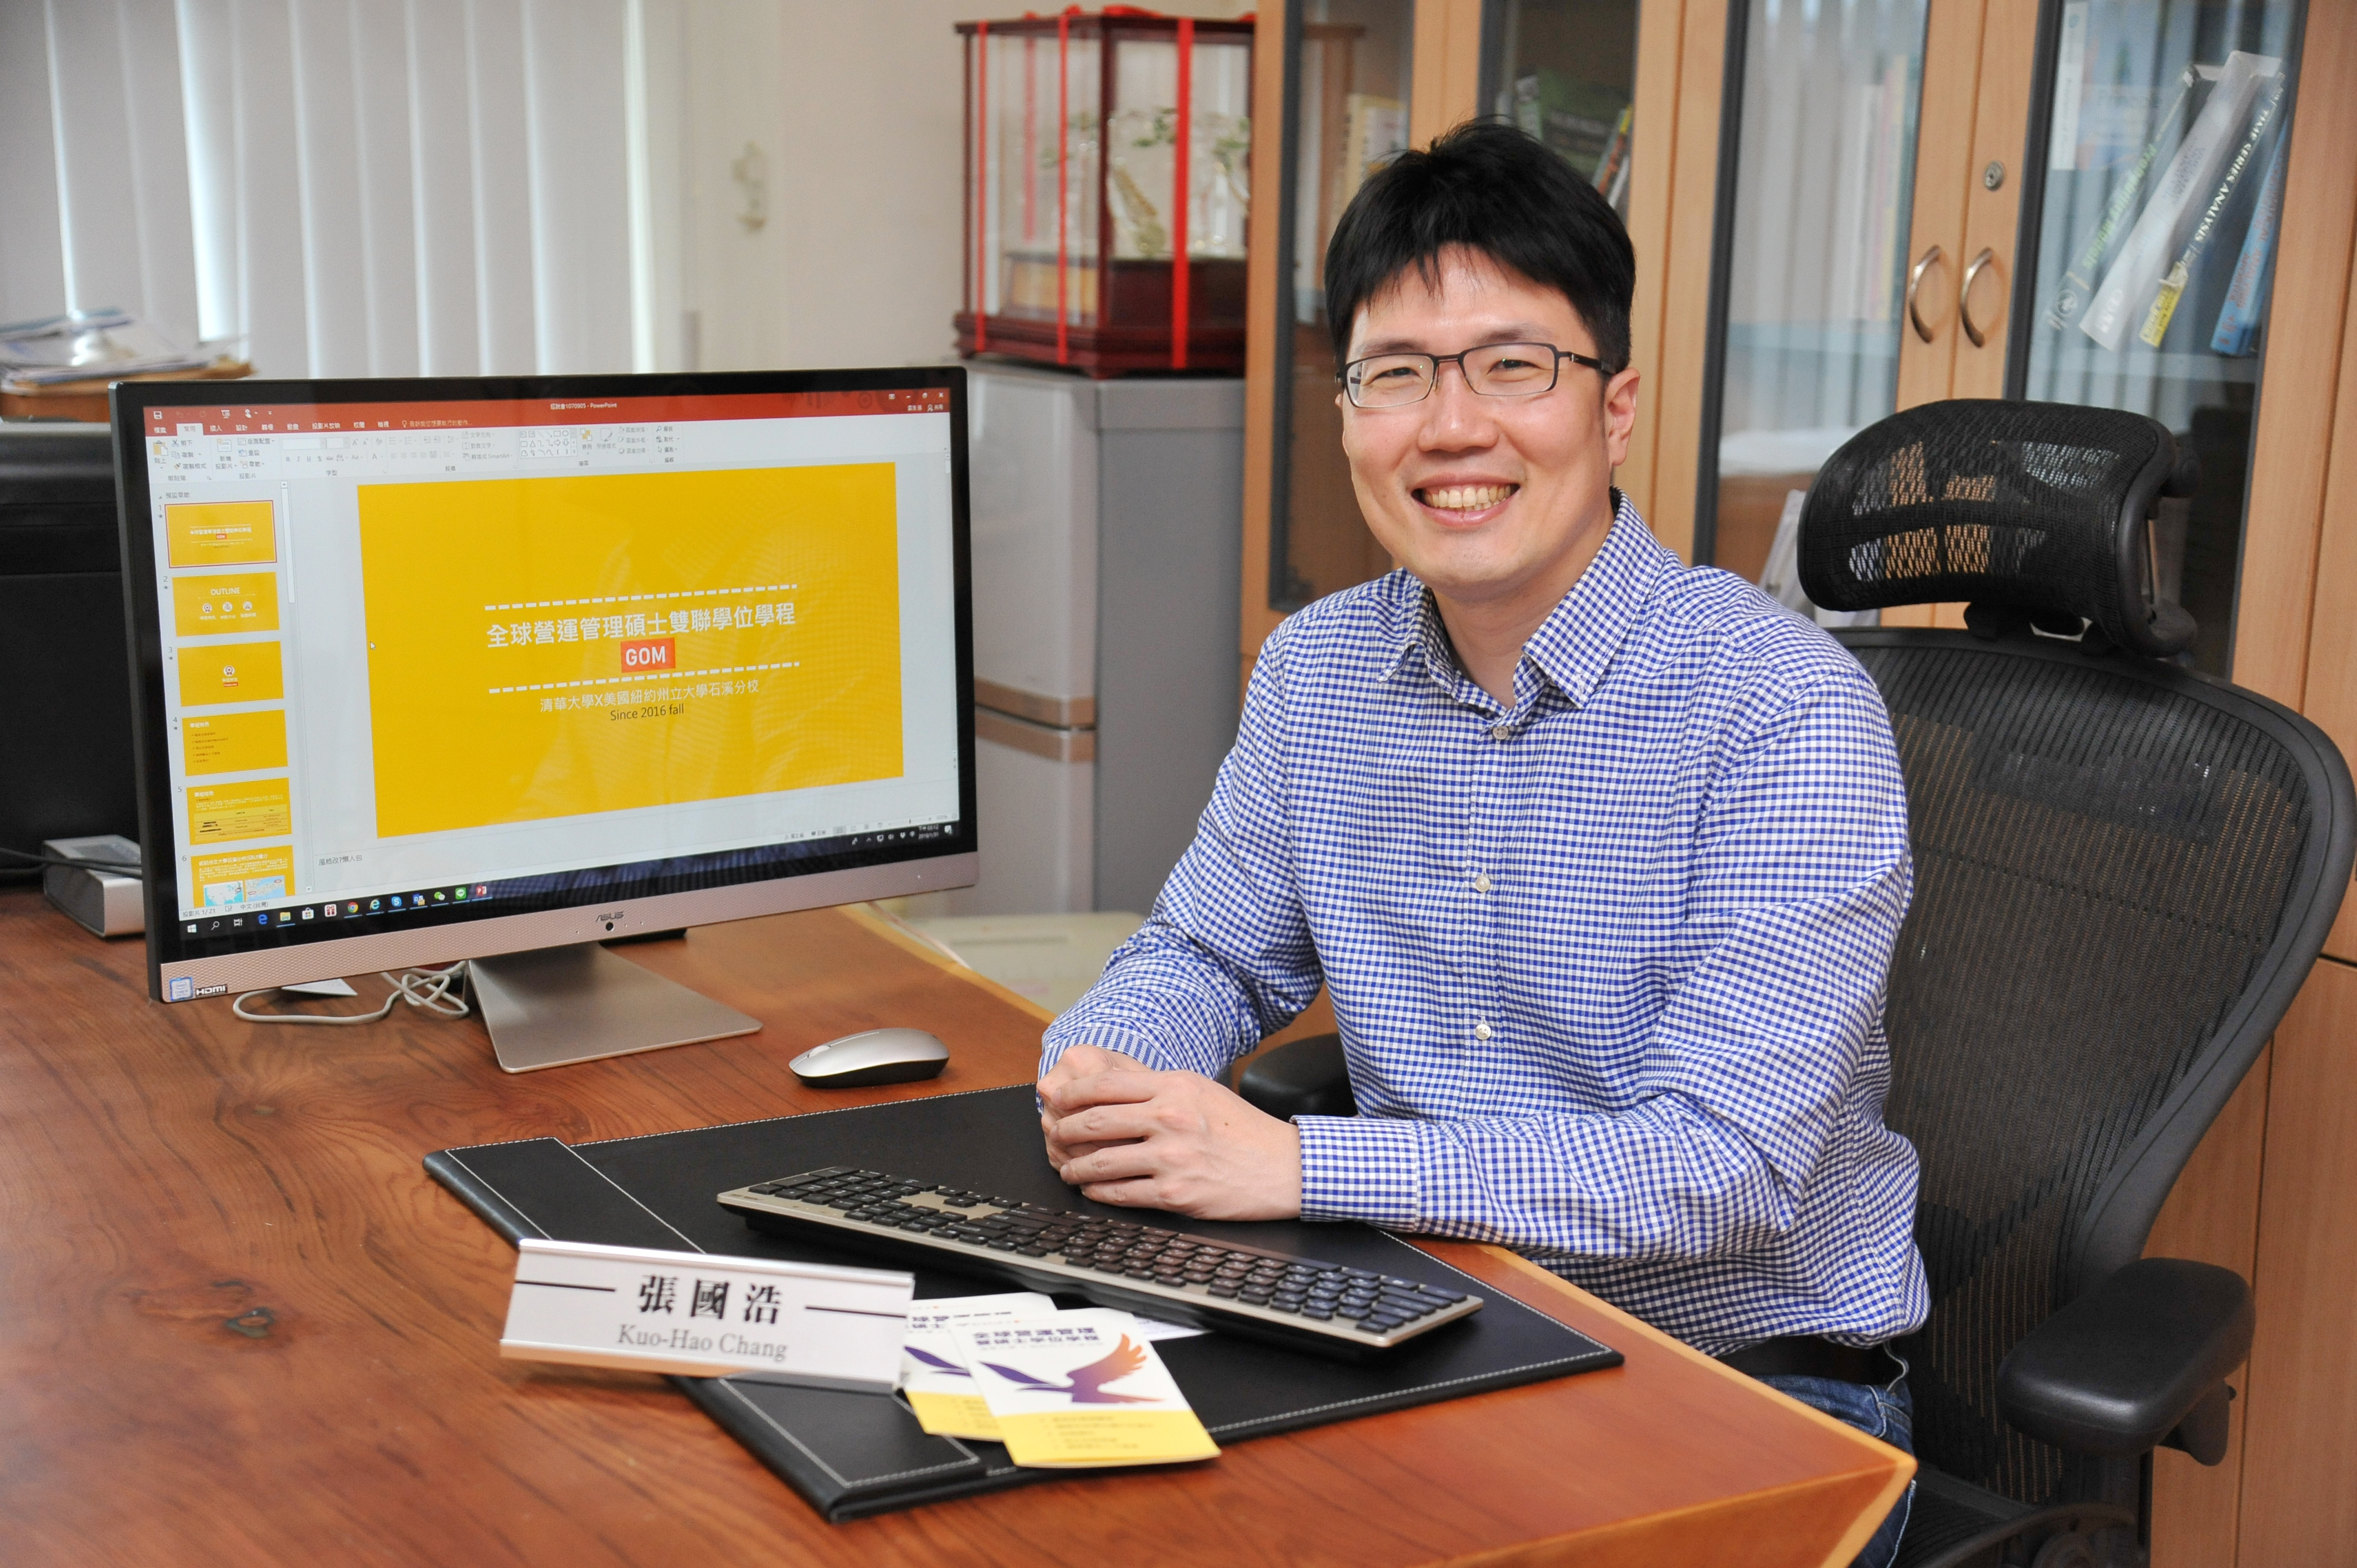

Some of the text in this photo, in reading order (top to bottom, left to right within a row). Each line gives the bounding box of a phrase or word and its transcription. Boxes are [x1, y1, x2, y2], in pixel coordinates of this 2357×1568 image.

[2226, 143, 2252, 183] SERIES
[2194, 182, 2229, 242] ANALYSIS
[210, 587, 240, 596] OUTLINE
[487, 602, 796, 648] 全球營運管理碩士雙聯學位學程
[625, 646, 666, 666] GOM
[540, 679, 759, 714] 清華大學X美國紐約州立大學石溪分校
[610, 703, 684, 721] Since 2016 fall
[596, 911, 624, 922] ASUS
[196, 986, 225, 996] HDMI
[639, 1275, 784, 1325] 張國浩
[616, 1323, 787, 1362] Kuo-Hao Chang
